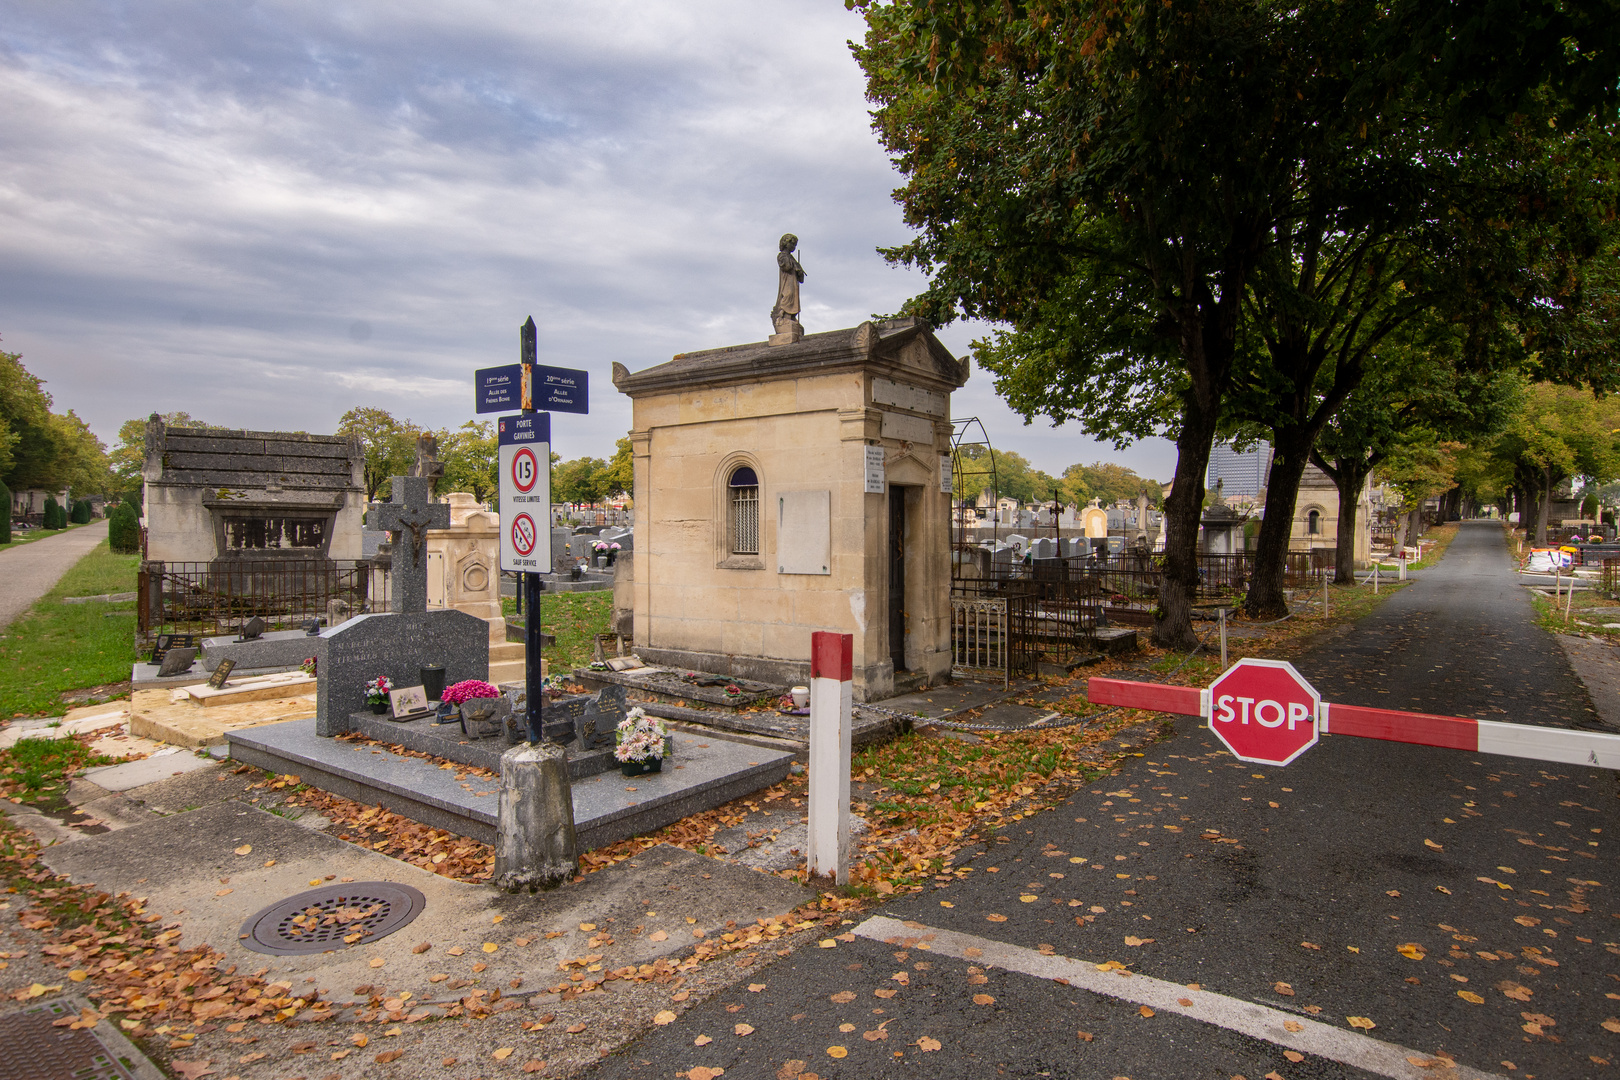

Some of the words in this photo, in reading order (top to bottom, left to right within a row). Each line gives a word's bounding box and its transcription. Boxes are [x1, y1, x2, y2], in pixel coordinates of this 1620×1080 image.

[516, 419, 532, 428] PORTE
[513, 430, 535, 440] GAVINIÈS
[519, 462, 531, 479] 15
[1217, 694, 1309, 731] STOP
